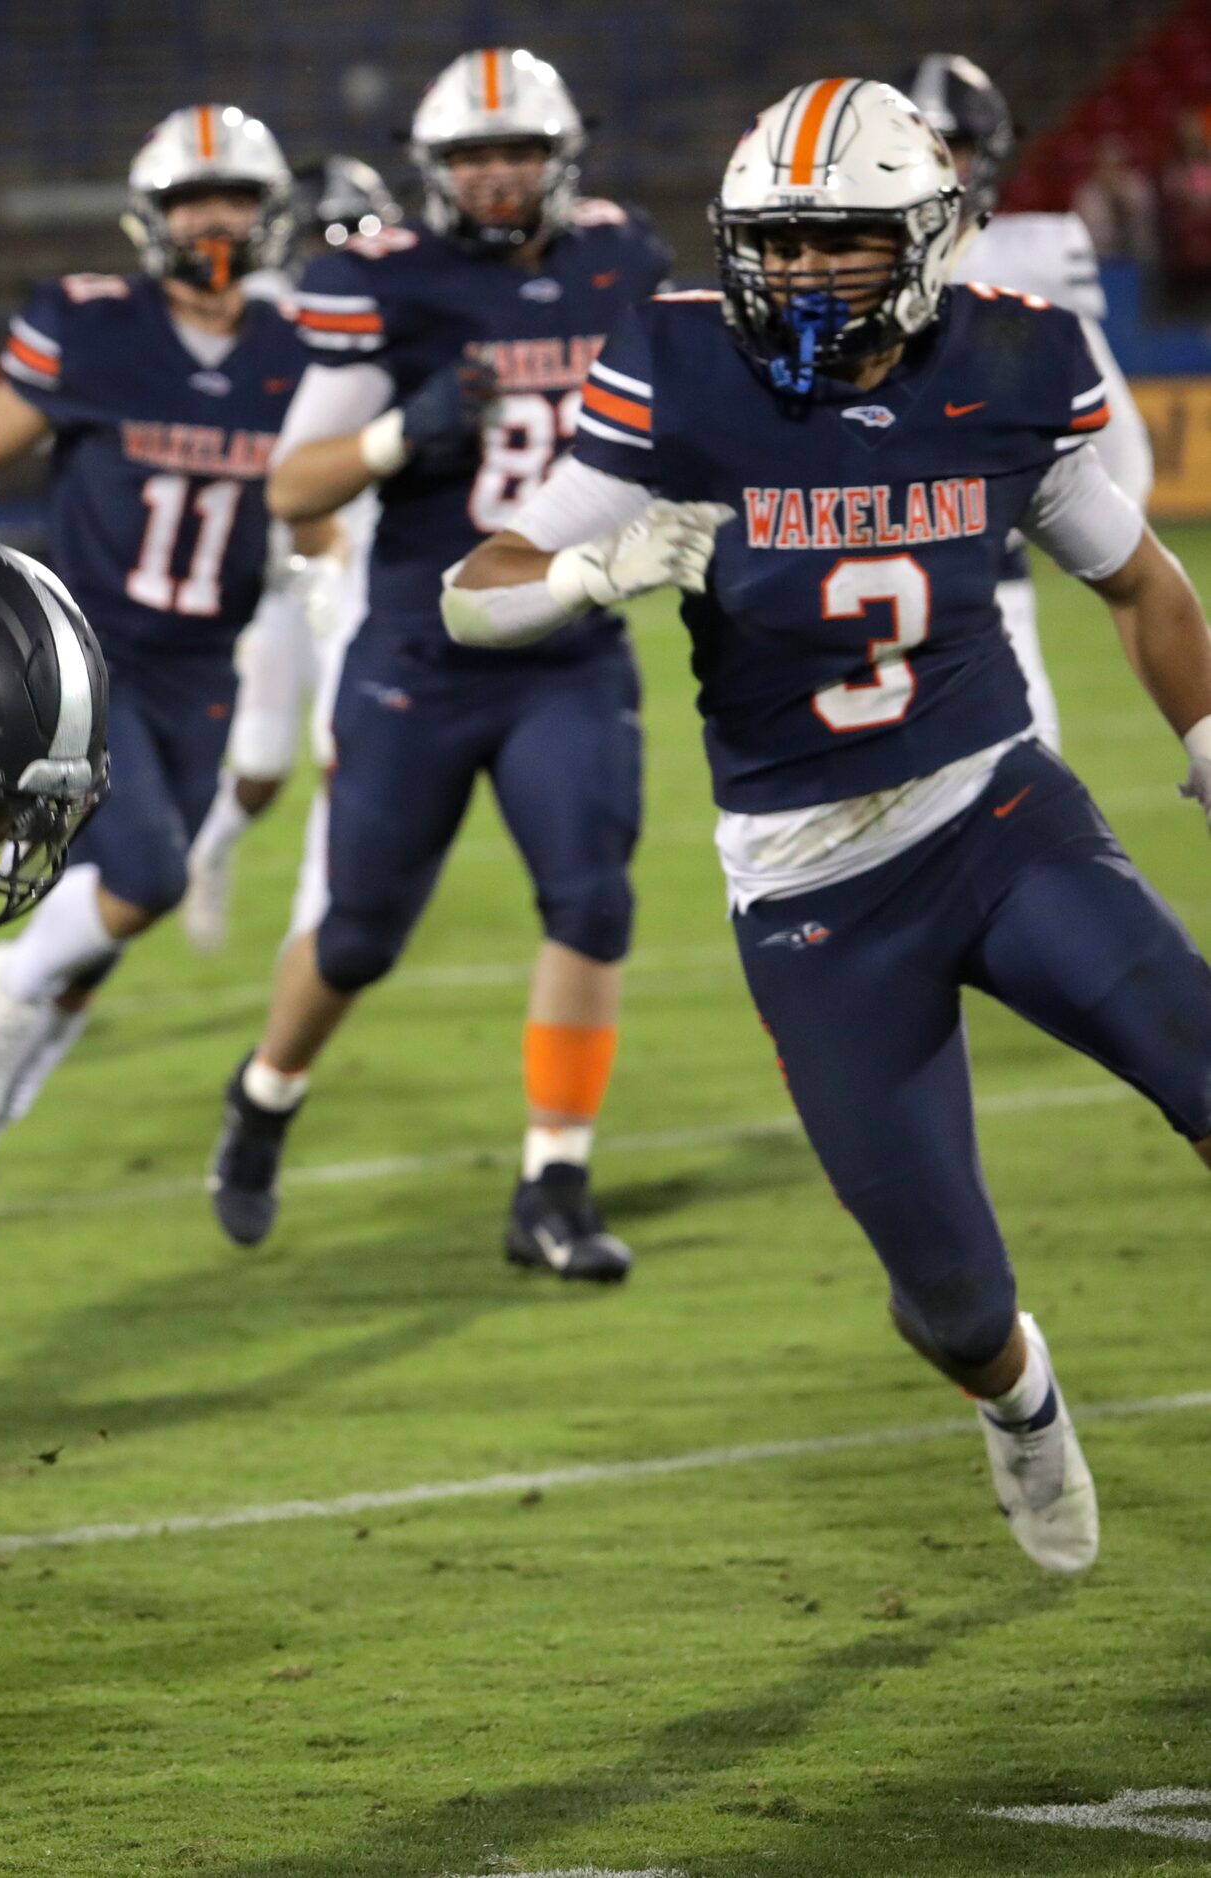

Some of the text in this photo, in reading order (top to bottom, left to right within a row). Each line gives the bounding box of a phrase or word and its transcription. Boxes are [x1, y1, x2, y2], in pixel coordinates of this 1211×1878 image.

[468, 392, 583, 534] 8
[742, 476, 987, 550] WAKELAND
[125, 474, 242, 617] 11
[810, 552, 932, 734] 3
